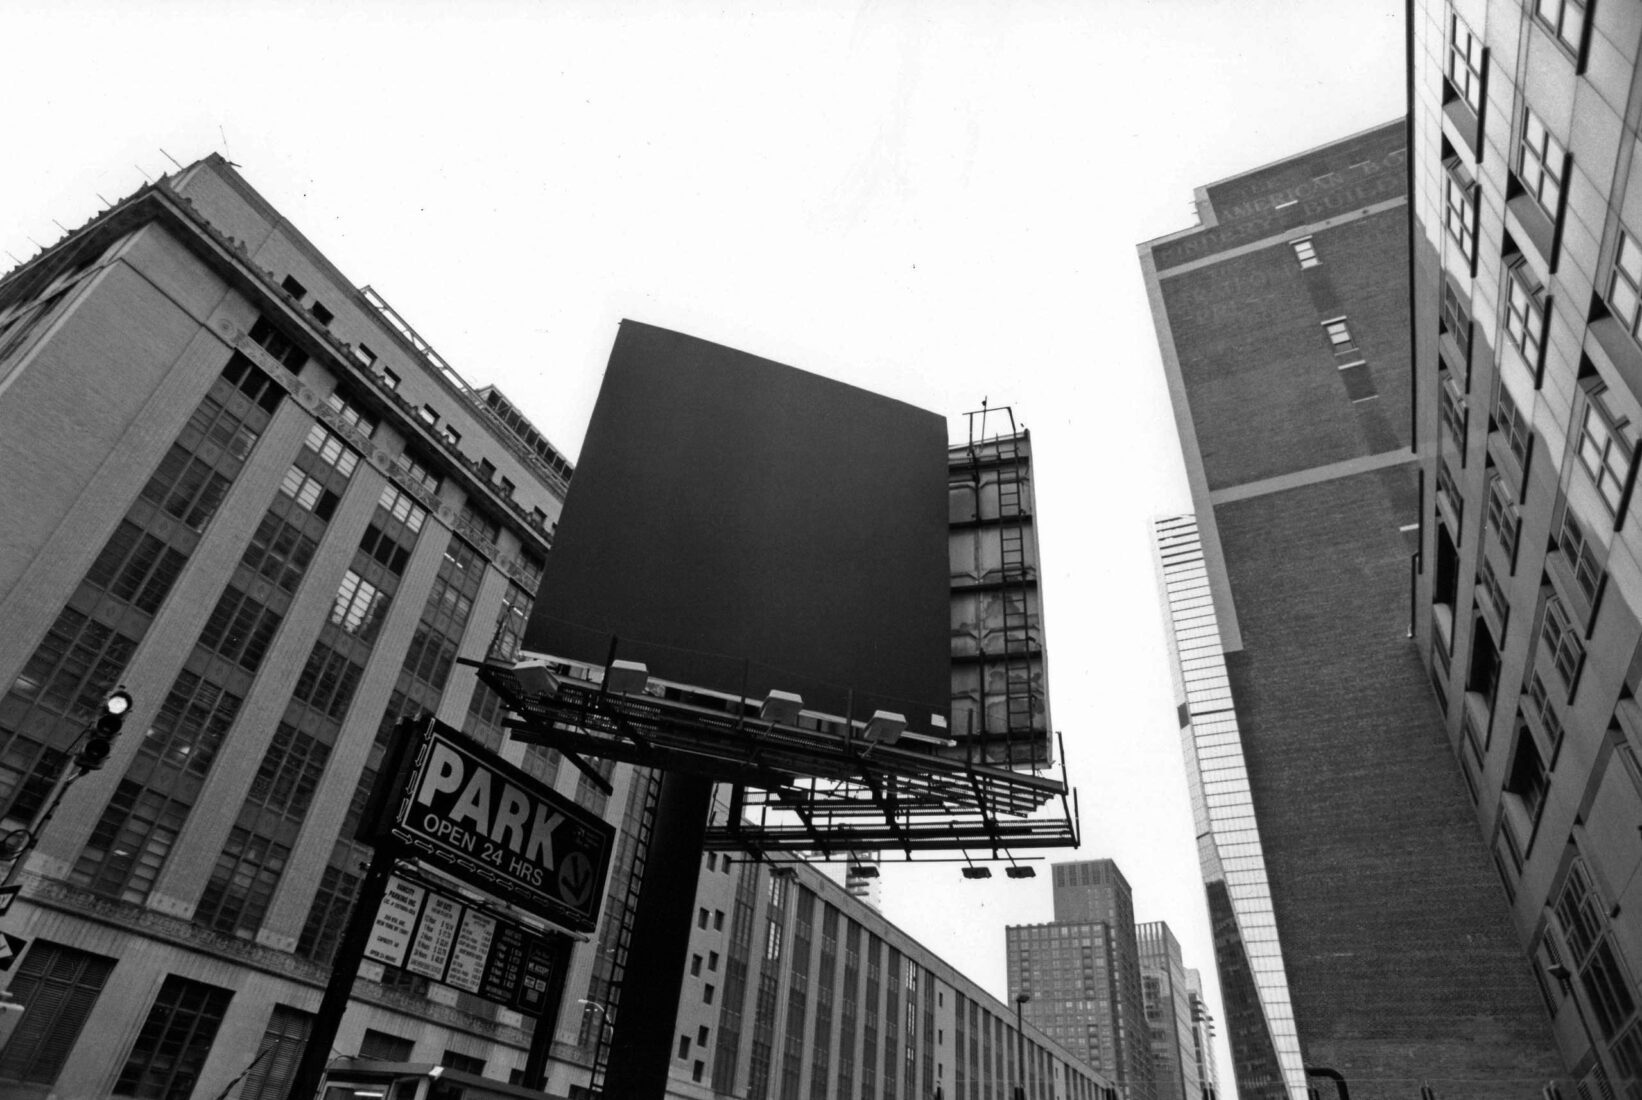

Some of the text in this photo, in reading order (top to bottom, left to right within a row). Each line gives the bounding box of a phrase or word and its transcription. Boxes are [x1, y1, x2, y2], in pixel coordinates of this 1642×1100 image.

[1220, 170, 1344, 223] AMERICAN
[417, 742, 565, 870] PARK
[423, 813, 544, 887] OPEN 24 HRS
